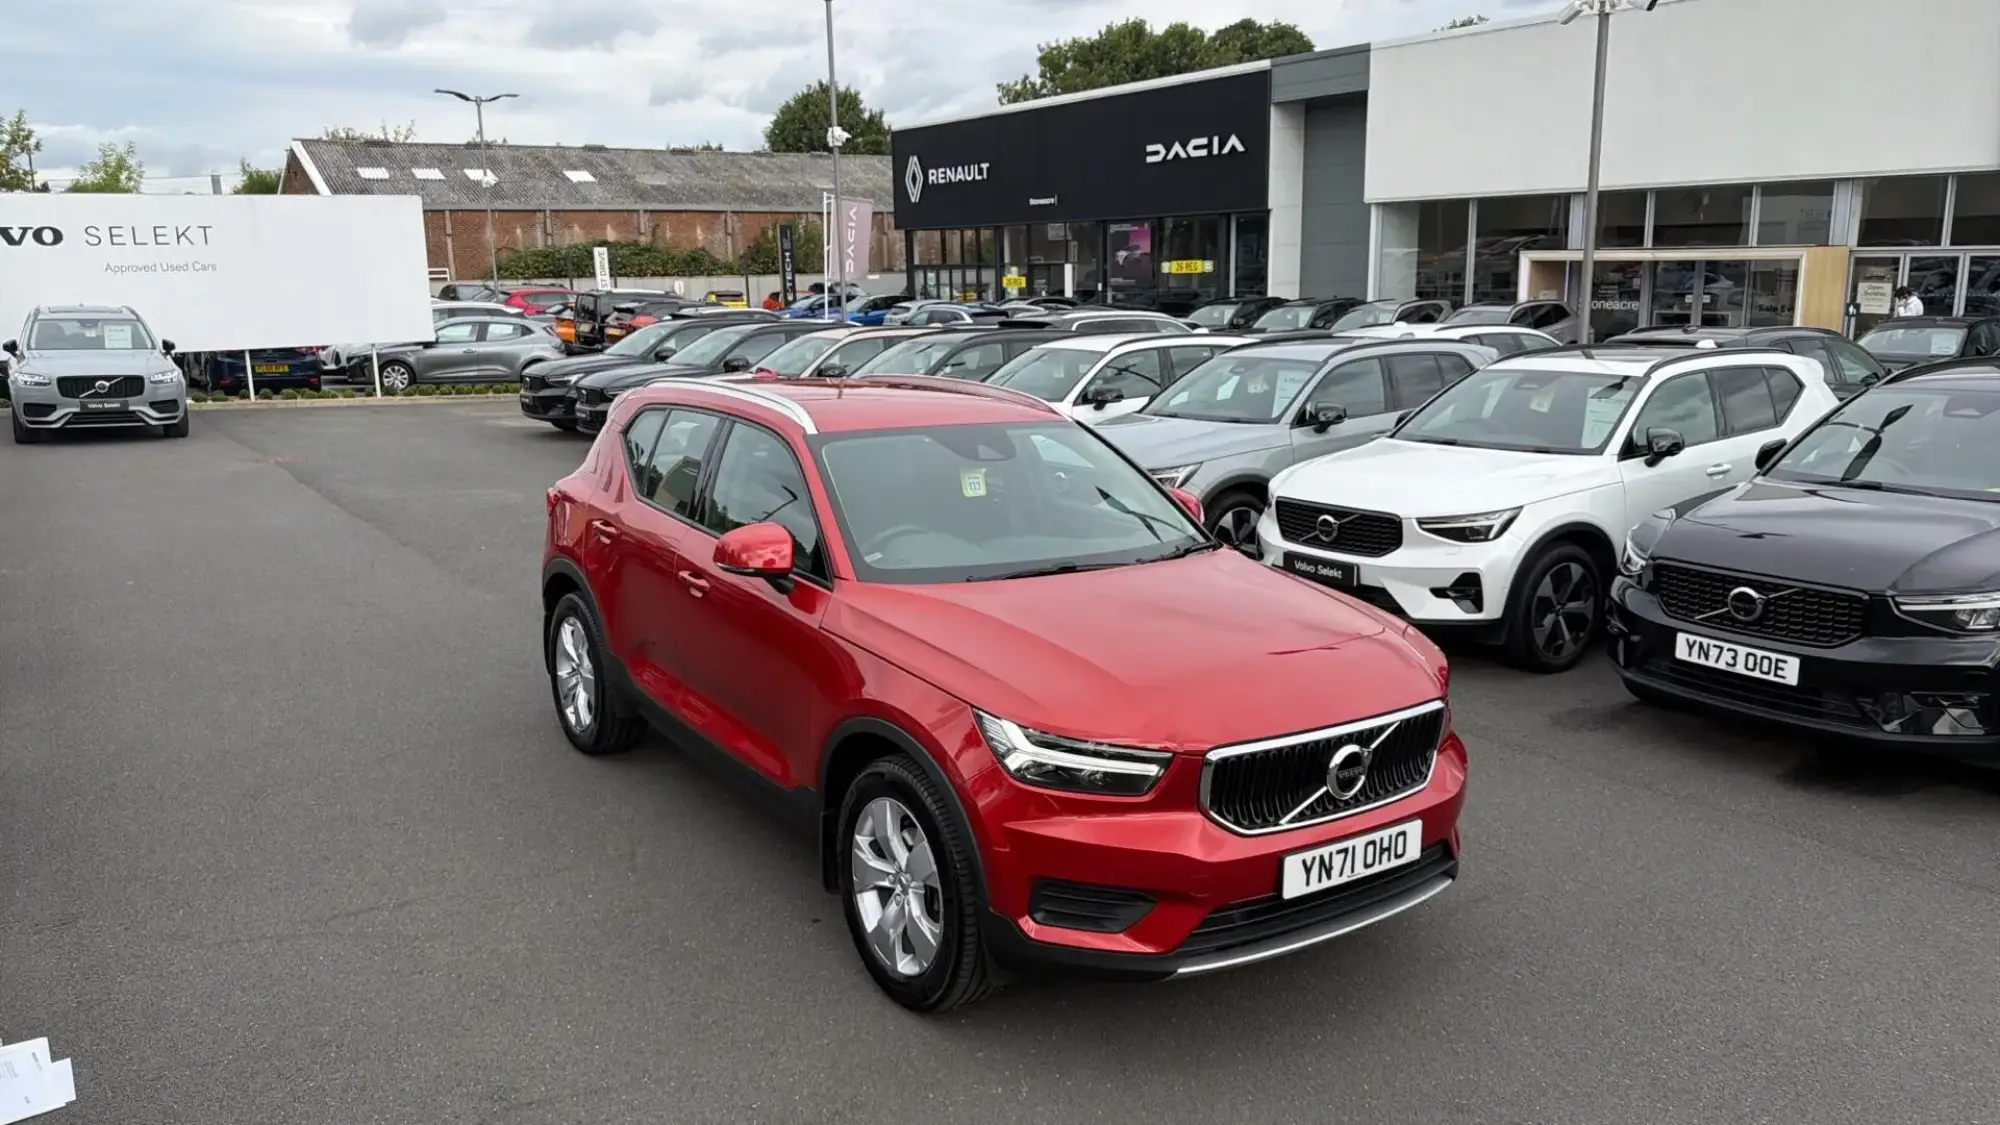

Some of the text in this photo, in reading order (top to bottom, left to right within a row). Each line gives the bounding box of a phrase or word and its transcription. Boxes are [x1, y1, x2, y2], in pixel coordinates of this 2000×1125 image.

[1145, 133, 1246, 163] DACIA
[928, 162, 990, 185] RENAULT
[84, 225, 213, 247] SELEKT
[845, 205, 859, 273] DACIA
[104, 260, 218, 276] Approved Used Cars
[597, 250, 607, 277] DRIVE
[1185, 262, 1198, 272] REG
[783, 251, 795, 302] E-TECH
[1578, 300, 1640, 310] oneacre
[1294, 559, 1343, 579] Volvo Selekt
[1685, 637, 1789, 680] YN73 OOE
[1301, 829, 1408, 888] YN71 OHO
